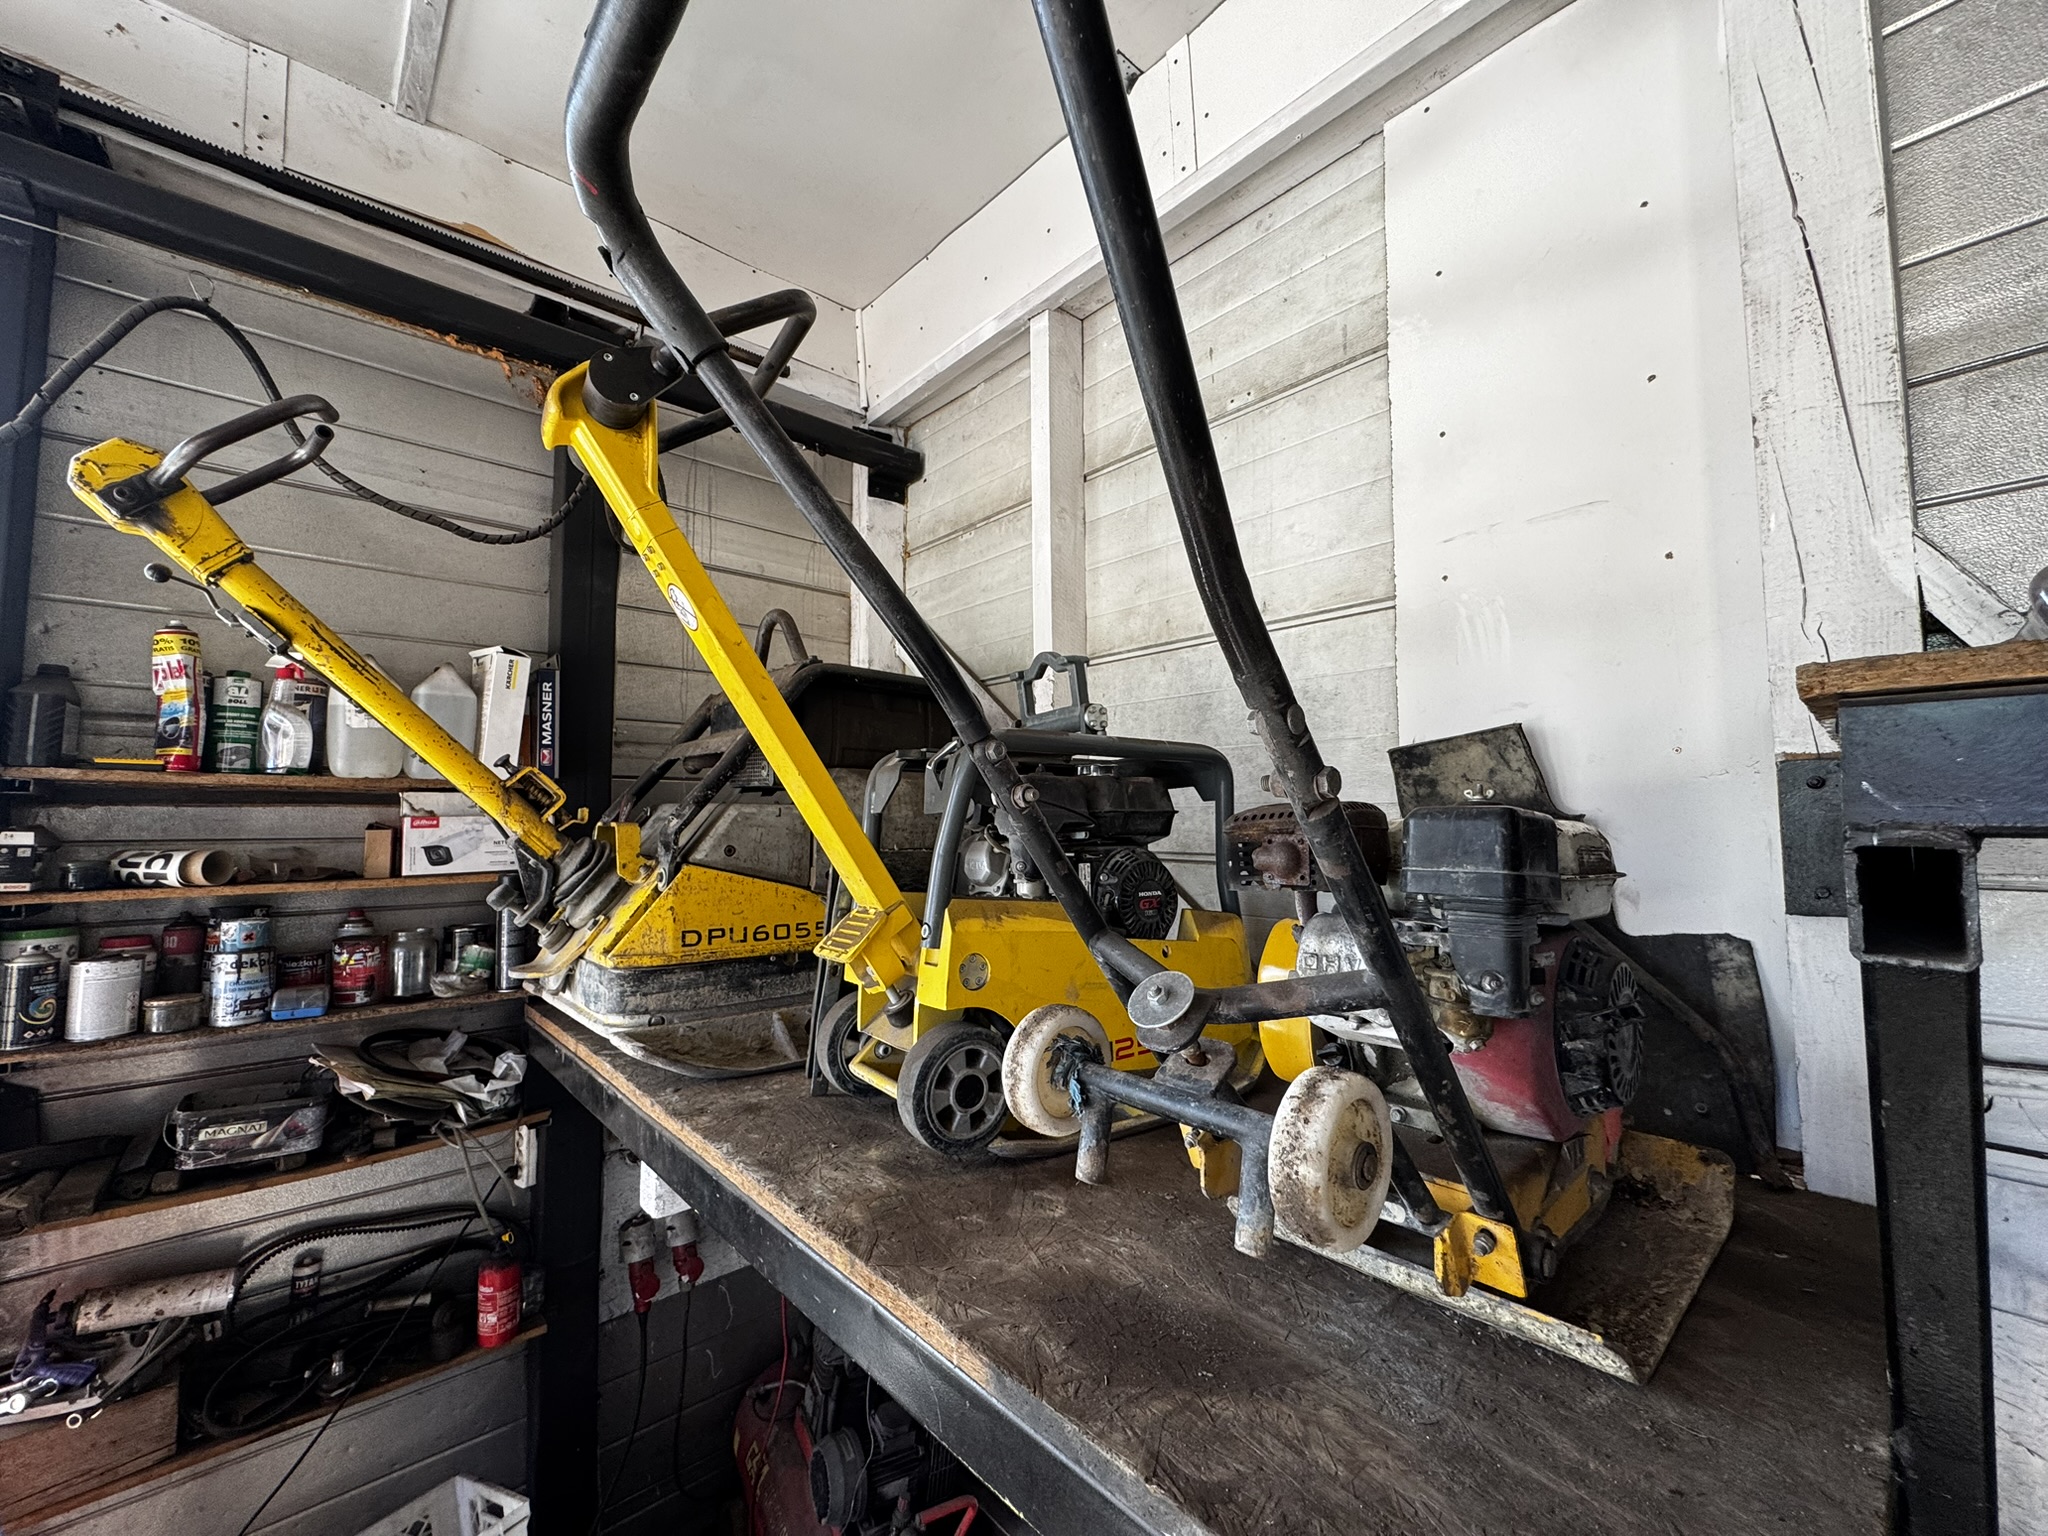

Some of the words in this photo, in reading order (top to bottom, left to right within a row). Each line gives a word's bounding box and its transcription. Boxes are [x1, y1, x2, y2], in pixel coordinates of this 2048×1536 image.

[153, 645, 175, 653] RATIS
[541, 682, 553, 745] MASNER
[1139, 897, 1161, 910] GX
[681, 920, 824, 948] DPU6055
[204, 1122, 267, 1139] MAGNAT
